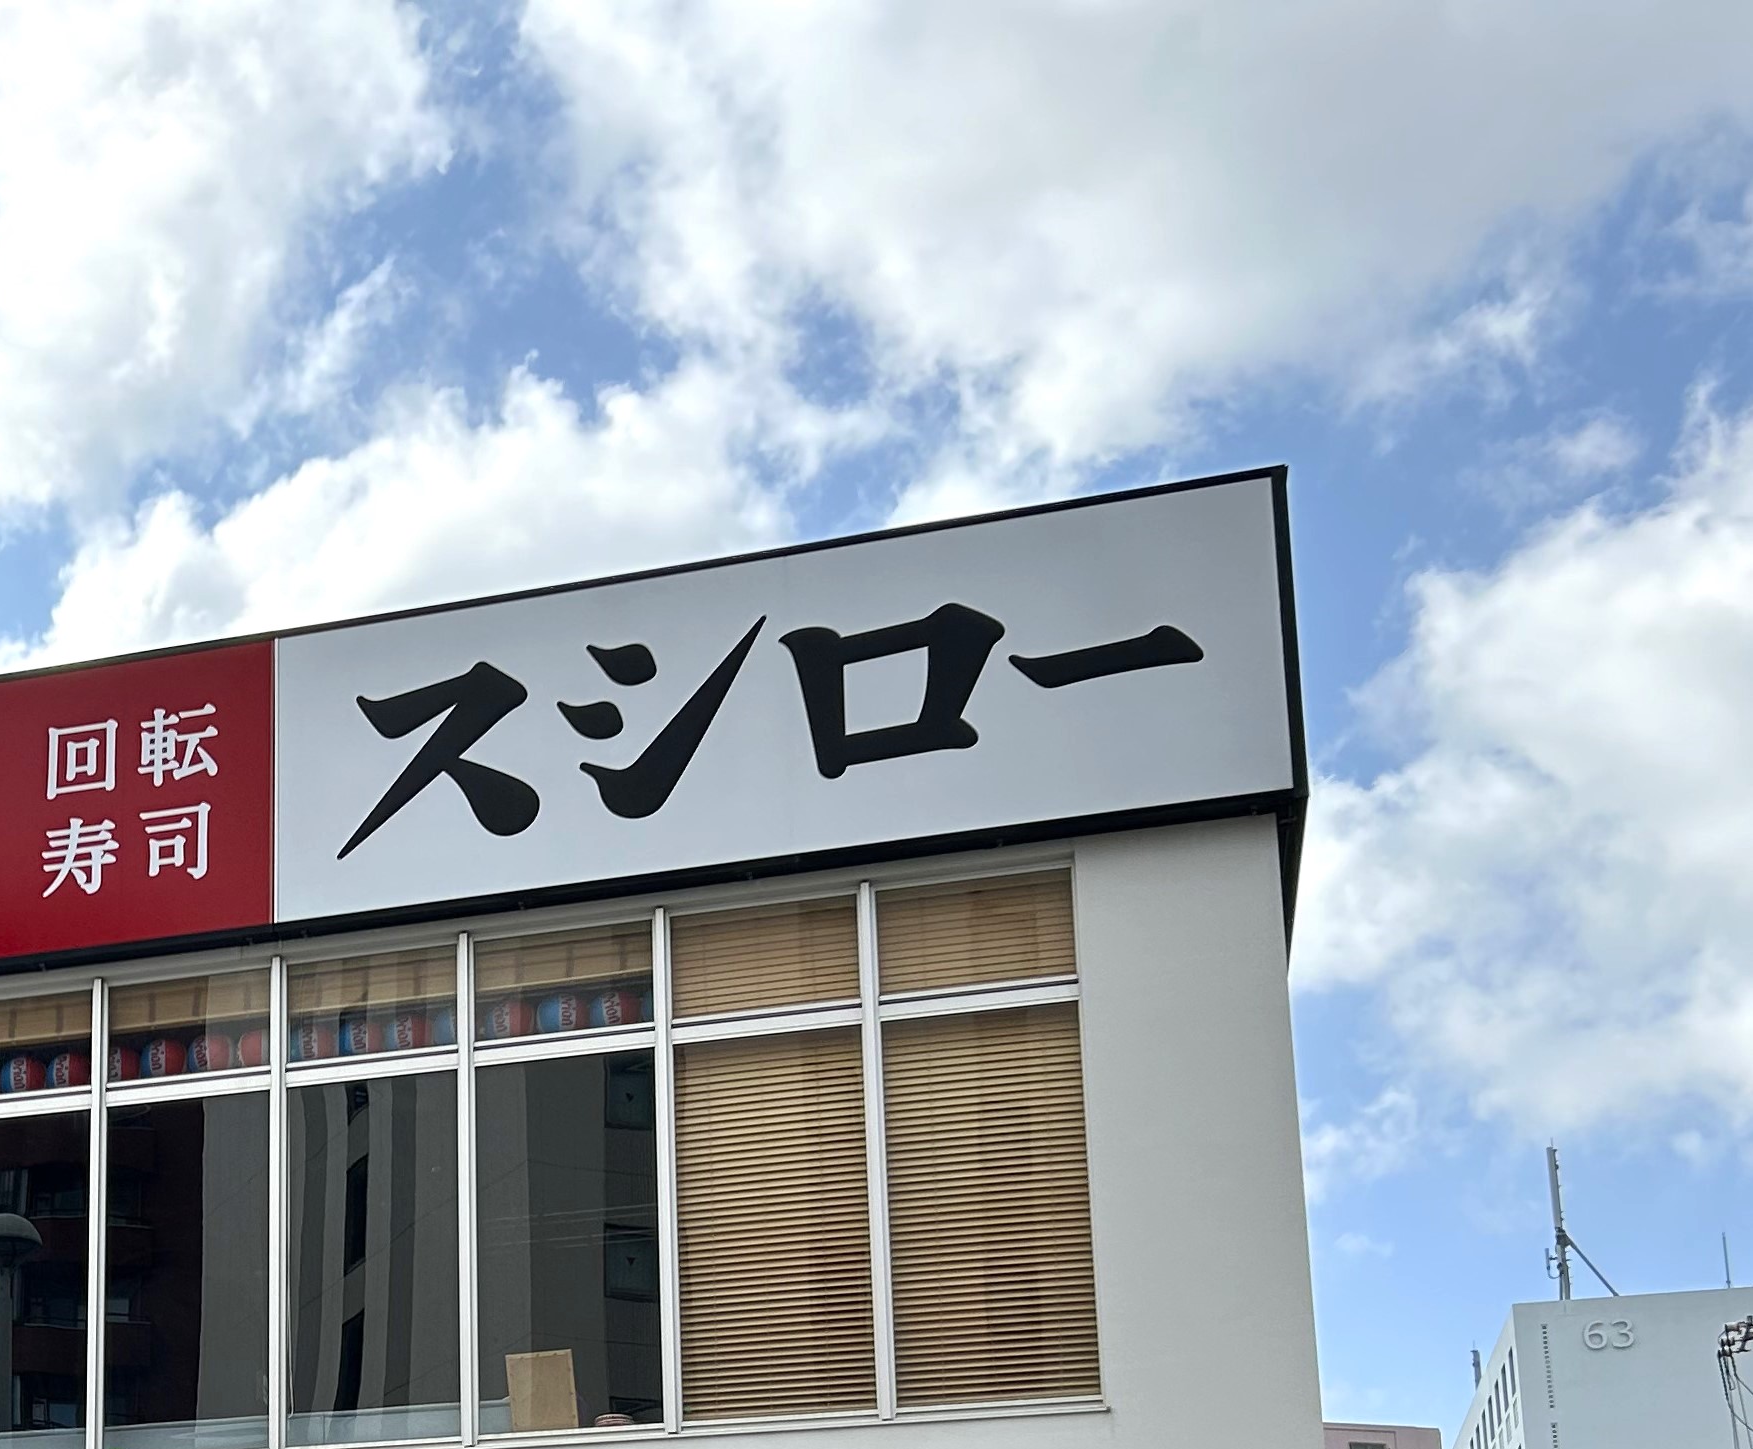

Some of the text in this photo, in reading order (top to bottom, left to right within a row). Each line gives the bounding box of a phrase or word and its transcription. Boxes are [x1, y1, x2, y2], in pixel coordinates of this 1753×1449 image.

[47, 702, 219, 800] 回転
[337, 602, 1204, 860] スシロー
[42, 802, 210, 898] 寿司
[1582, 1318, 1635, 1350] 63
